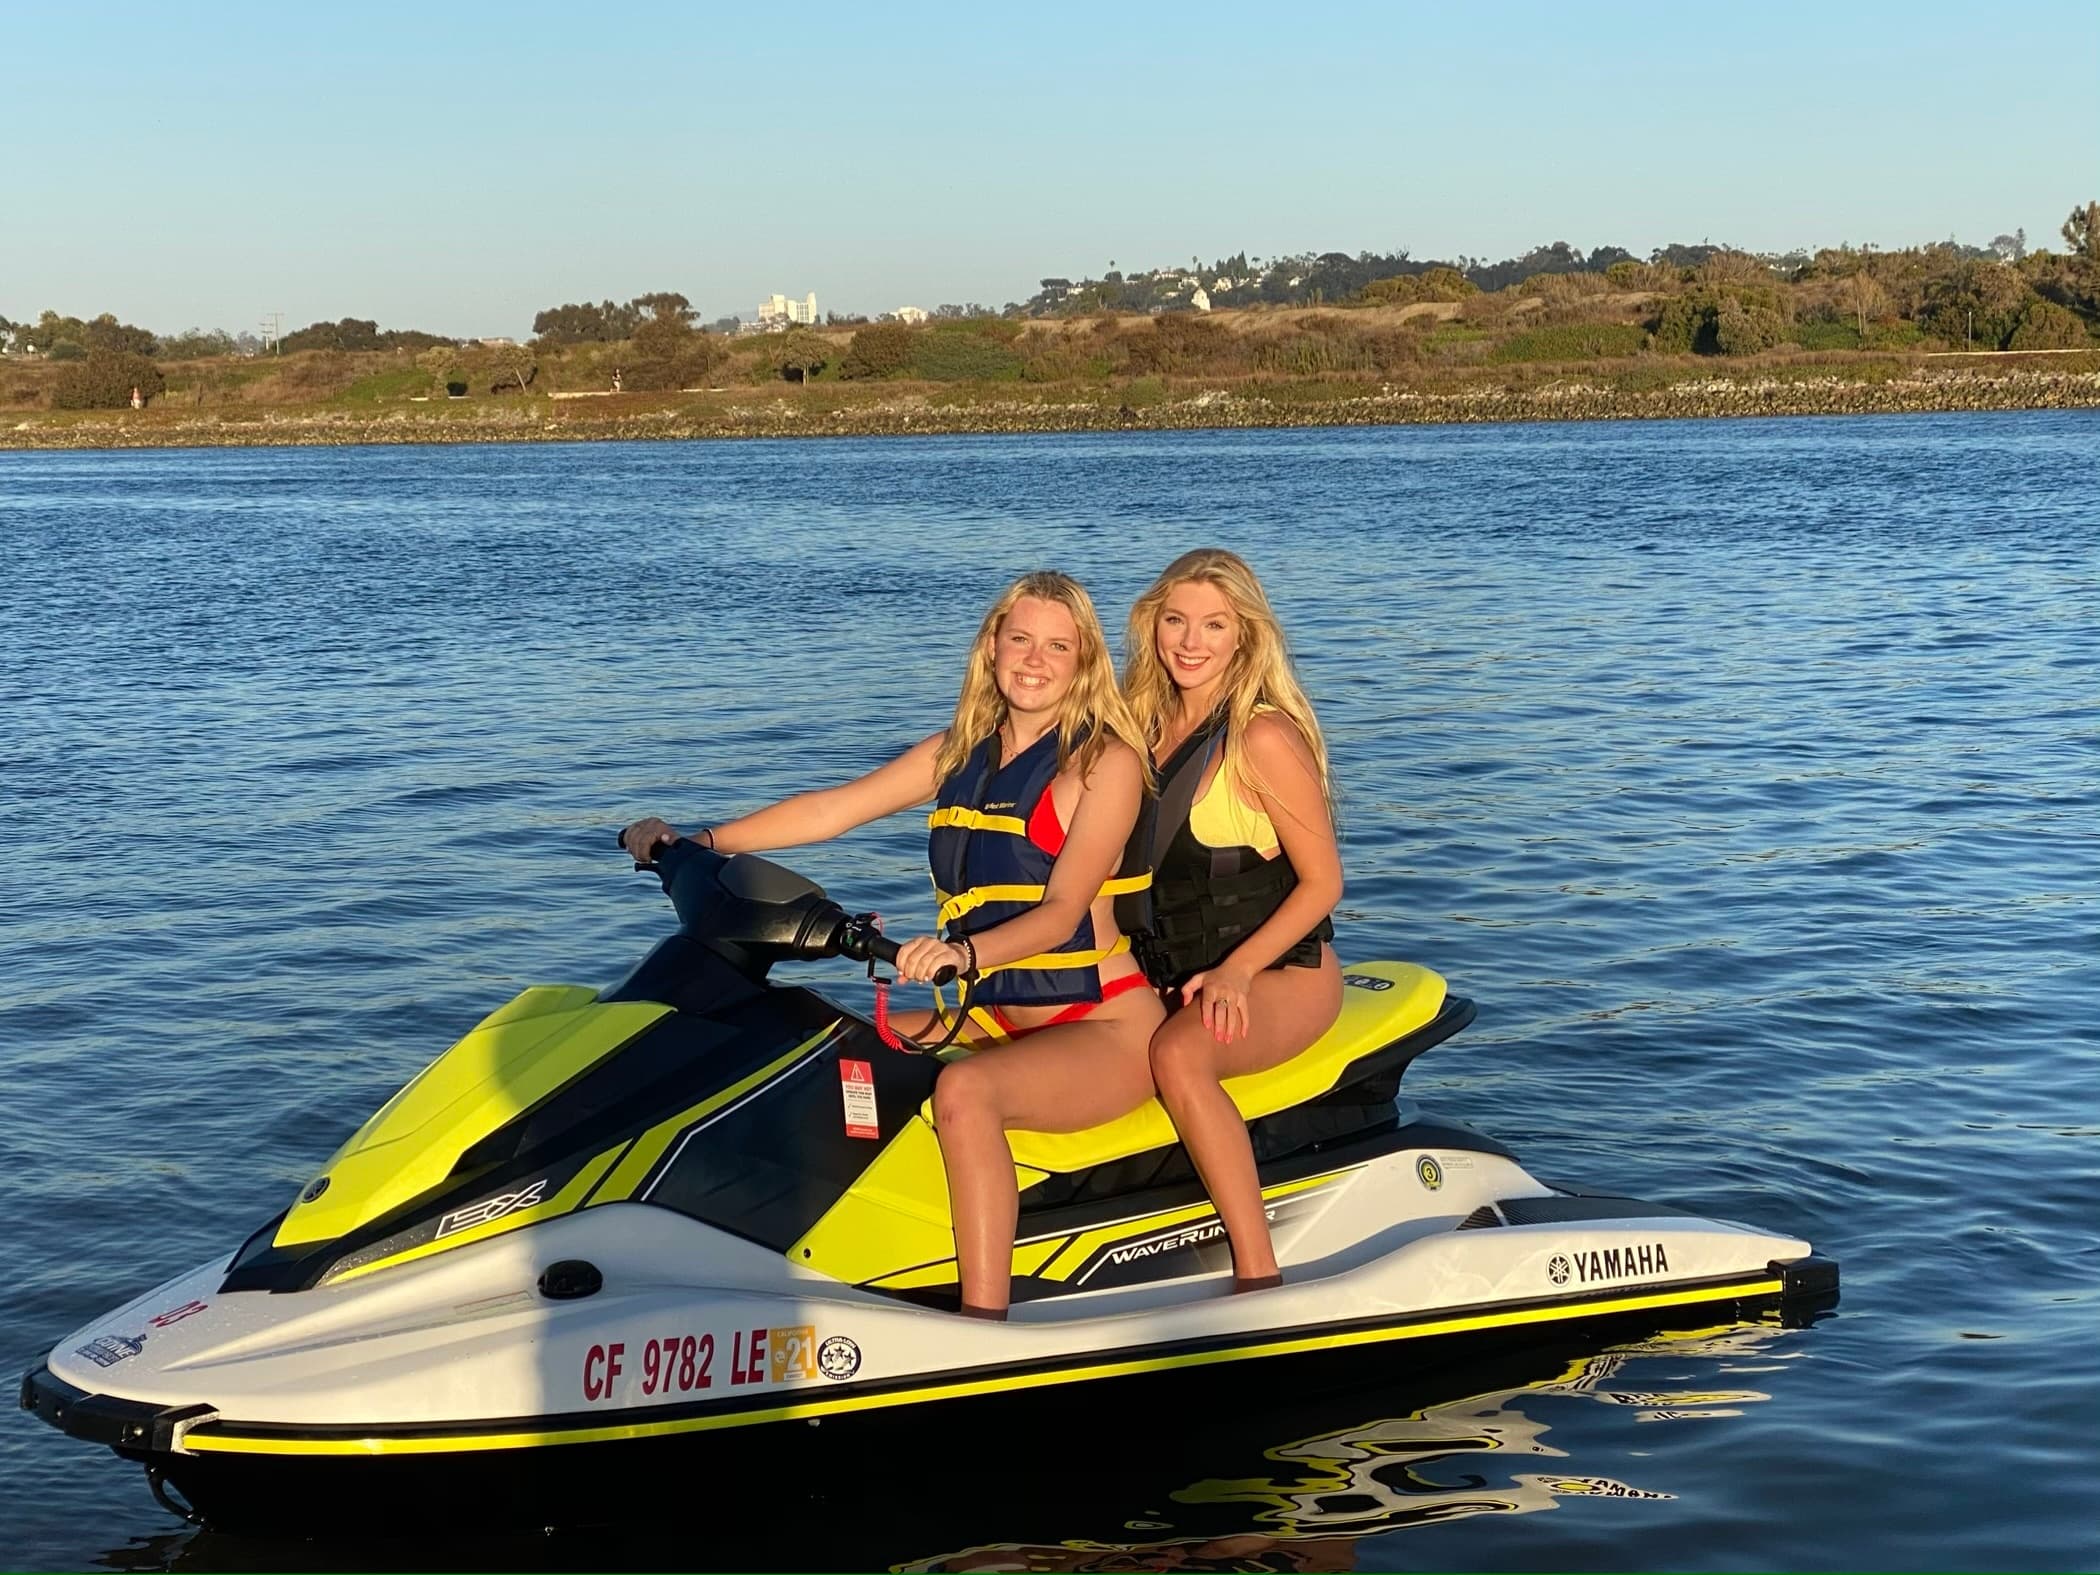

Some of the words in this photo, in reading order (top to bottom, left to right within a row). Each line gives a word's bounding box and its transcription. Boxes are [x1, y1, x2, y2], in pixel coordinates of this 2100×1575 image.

[434, 1179, 547, 1240] EX
[1111, 1210, 1276, 1265] WAVERUNR
[1573, 1243, 1669, 1283] YAMAHA
[583, 1343, 625, 1402] CF
[642, 1334, 714, 1396] 9782
[730, 1329, 768, 1386] LE
[786, 1335, 813, 1372] 21
